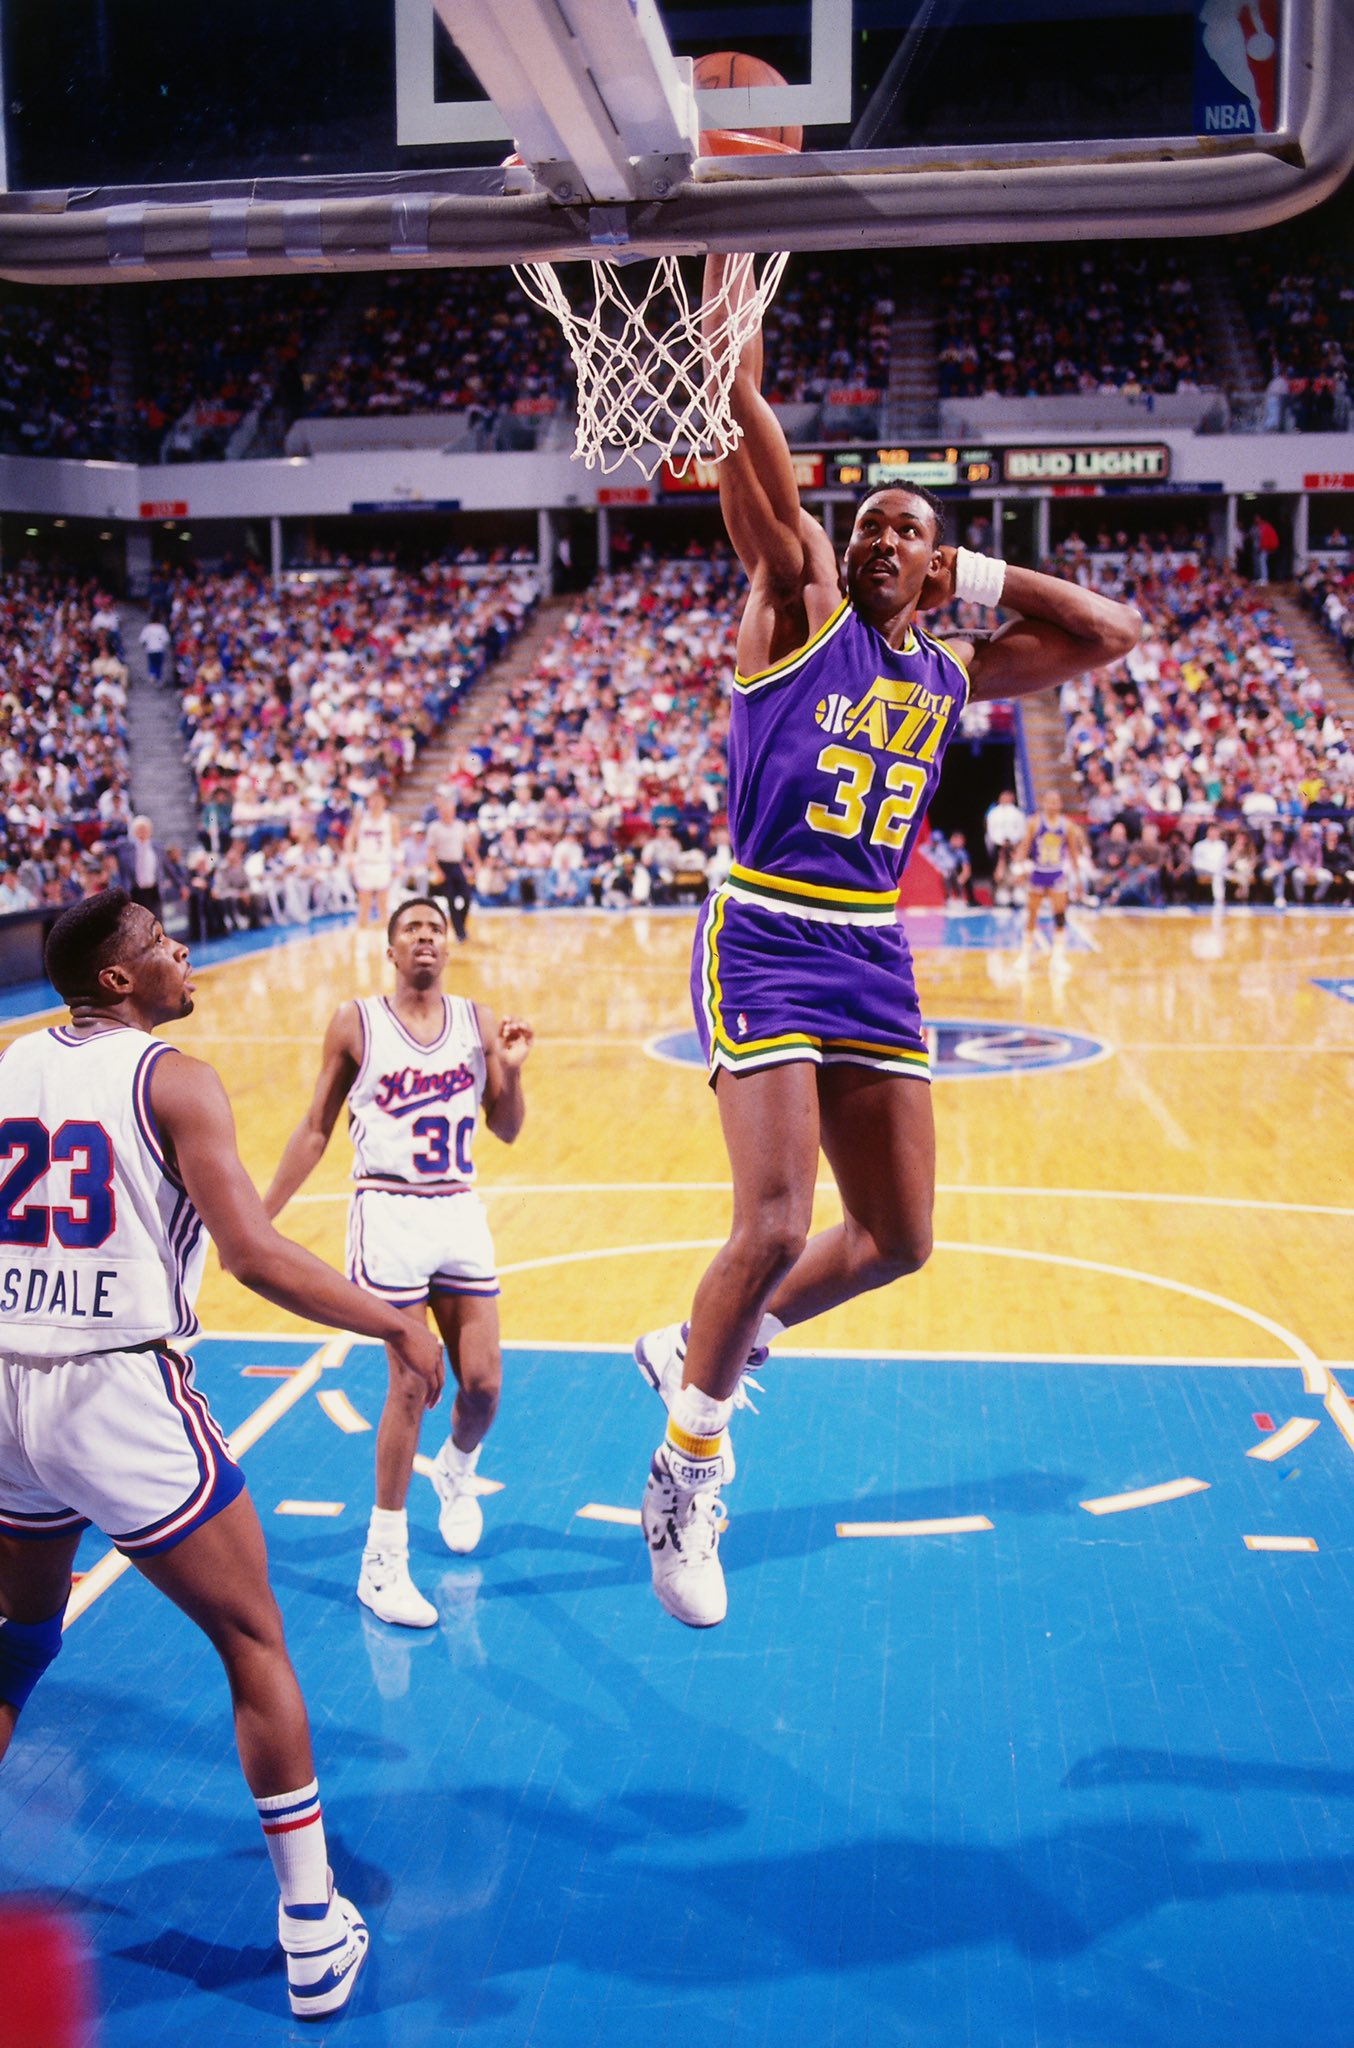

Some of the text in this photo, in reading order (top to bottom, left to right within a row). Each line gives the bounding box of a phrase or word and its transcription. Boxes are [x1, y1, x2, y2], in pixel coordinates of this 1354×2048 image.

[1205, 104, 1251, 130] NBA
[1008, 452, 1073, 477] BUD
[1075, 450, 1164, 475] LIGHT
[917, 688, 957, 717] UTA
[805, 743, 928, 850] 32
[375, 1062, 475, 1110] Kings
[412, 1115, 475, 1175] 30
[0, 1116, 117, 1250] 23
